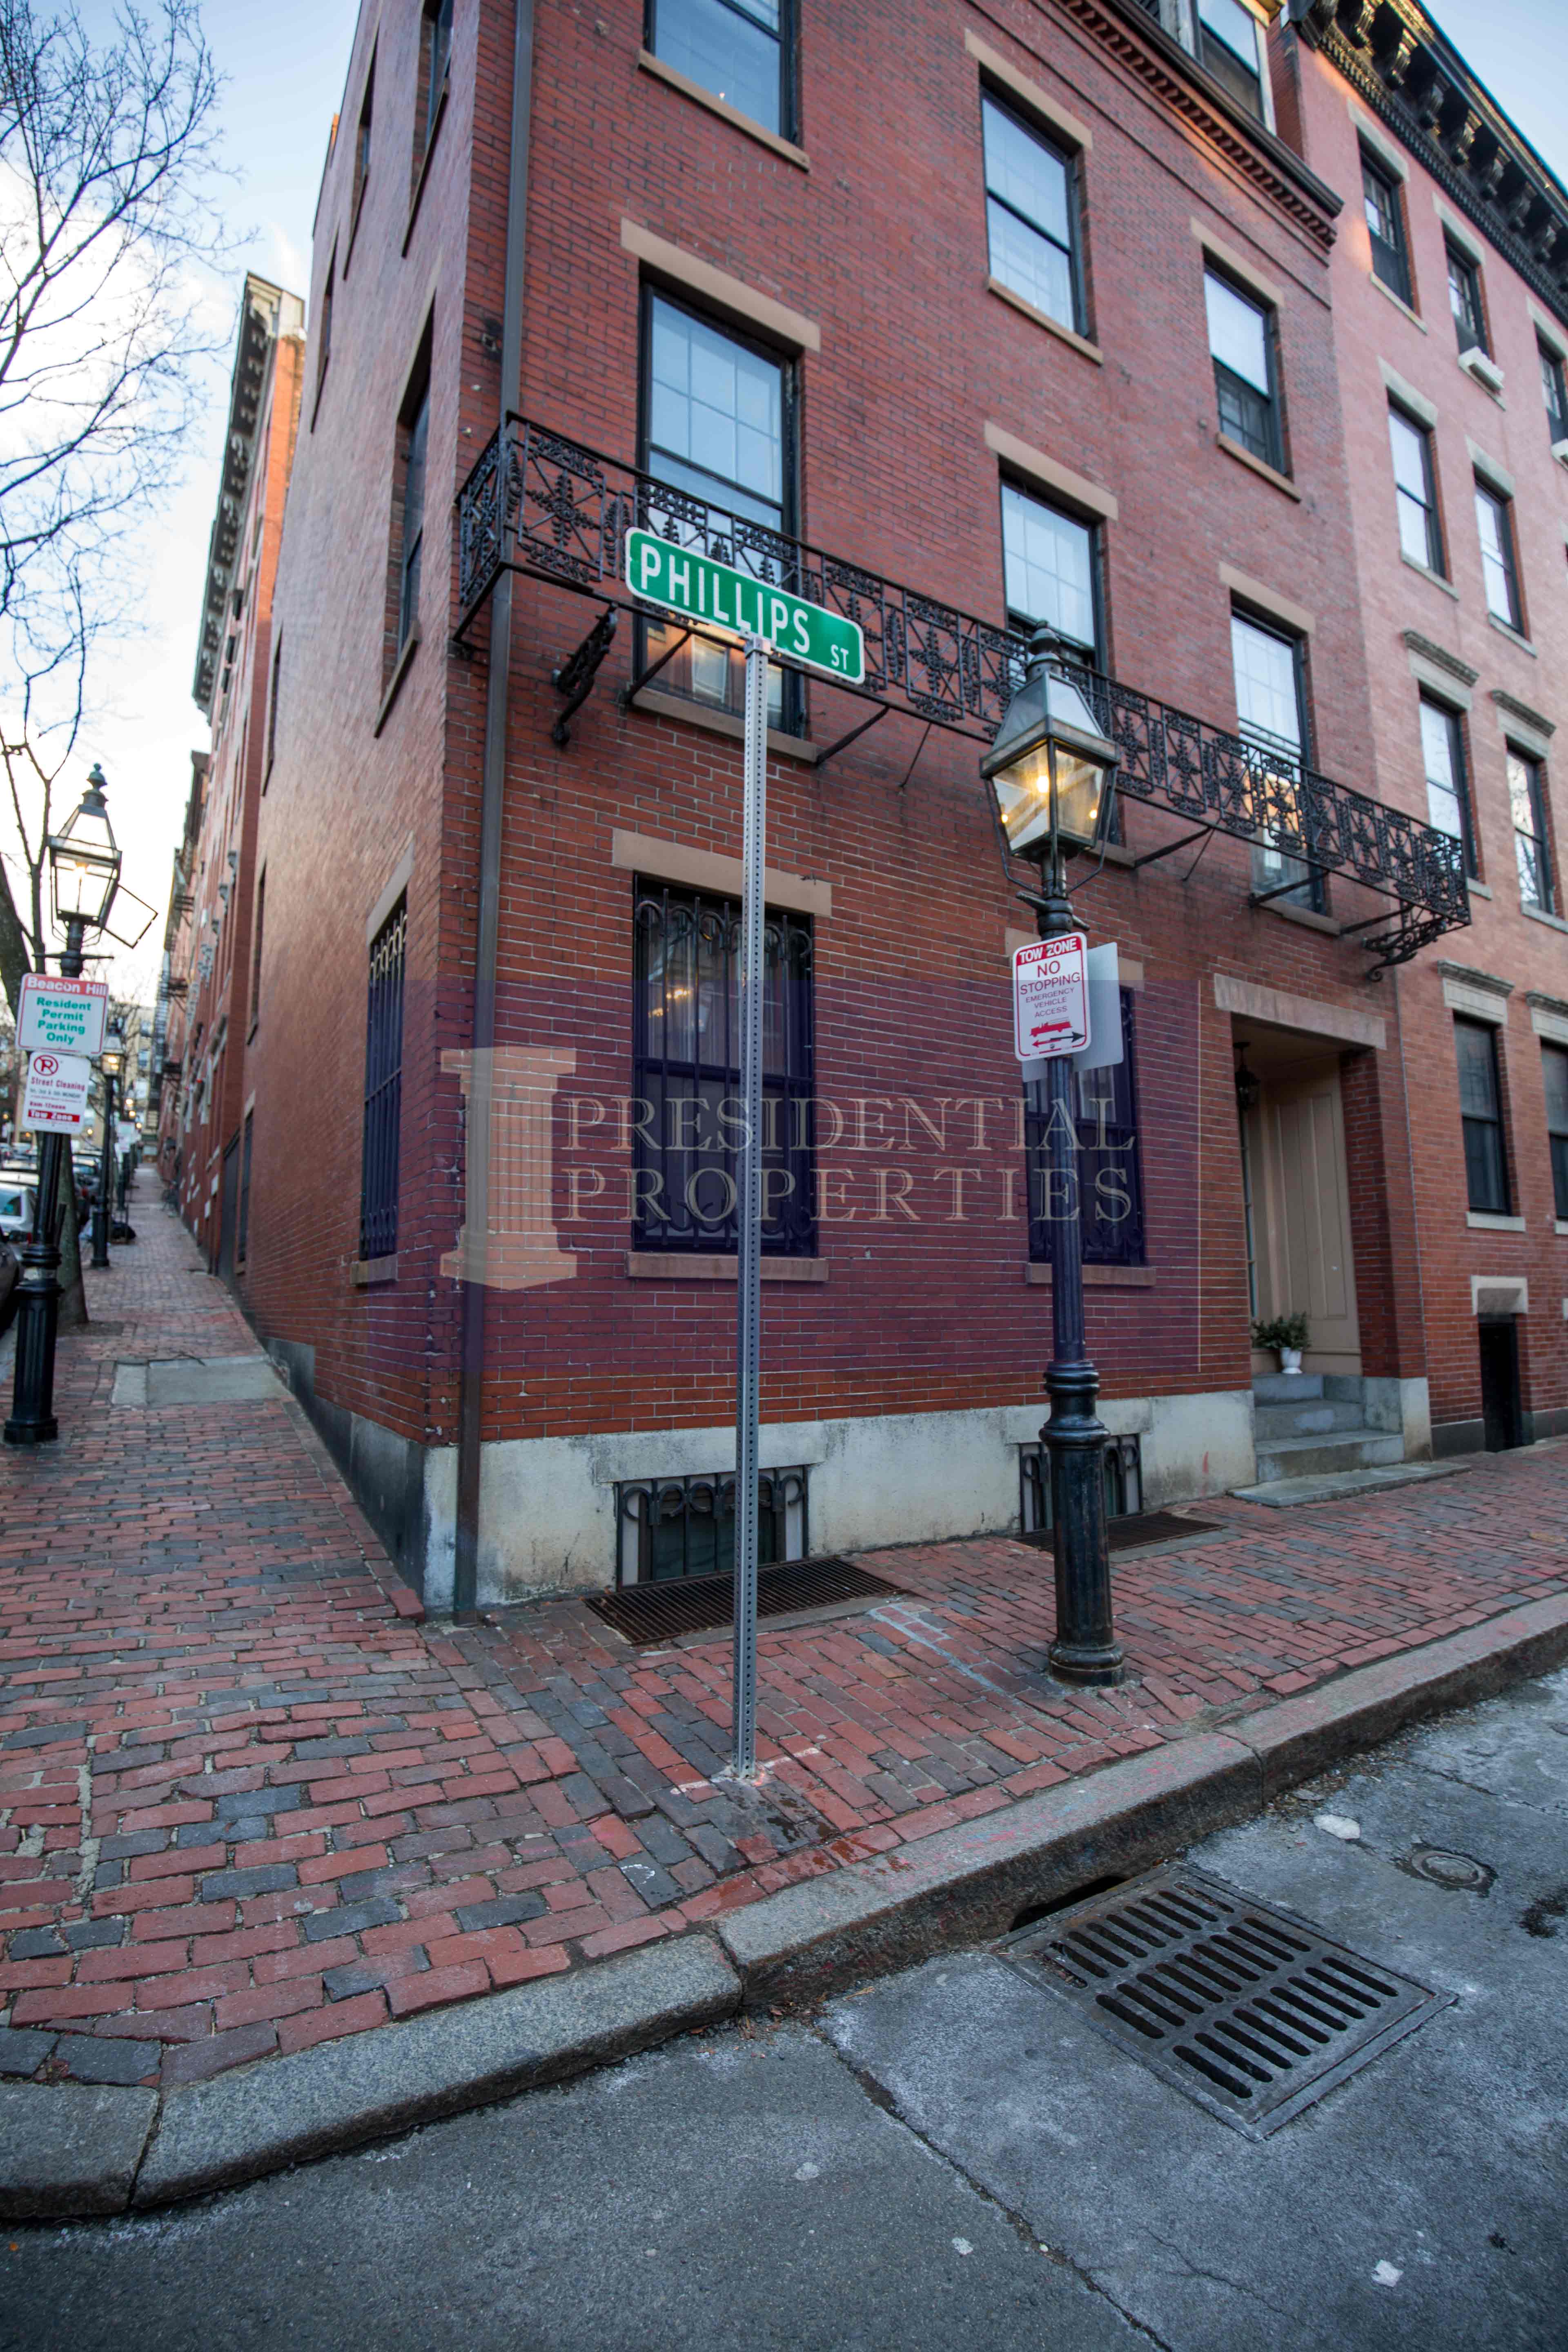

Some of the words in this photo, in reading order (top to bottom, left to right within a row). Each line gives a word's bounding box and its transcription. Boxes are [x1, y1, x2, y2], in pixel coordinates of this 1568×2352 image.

[641, 543, 810, 653] PHILLIPS
[831, 644, 849, 670] ST
[1019, 947, 1043, 964] TOW
[1046, 938, 1077, 957] ZONE
[1037, 960, 1060, 978] NO
[28, 976, 80, 993] Beacon
[85, 983, 106, 995] Hill
[1020, 972, 1080, 995] STOPPING
[1026, 987, 1075, 1003] EMERGENCY
[37, 997, 91, 1011] Resident
[1034, 997, 1067, 1009] VEHICLE
[42, 1009, 83, 1021] Permit
[1034, 1006, 1068, 1018] ACCESS
[38, 1020, 85, 1035] Parking
[46, 1032, 75, 1045] Only
[31, 1077, 53, 1086] Street
[56, 1080, 85, 1091] Cleaning
[31, 1110, 48, 1119] Tow
[52, 1111, 73, 1121] Zone
